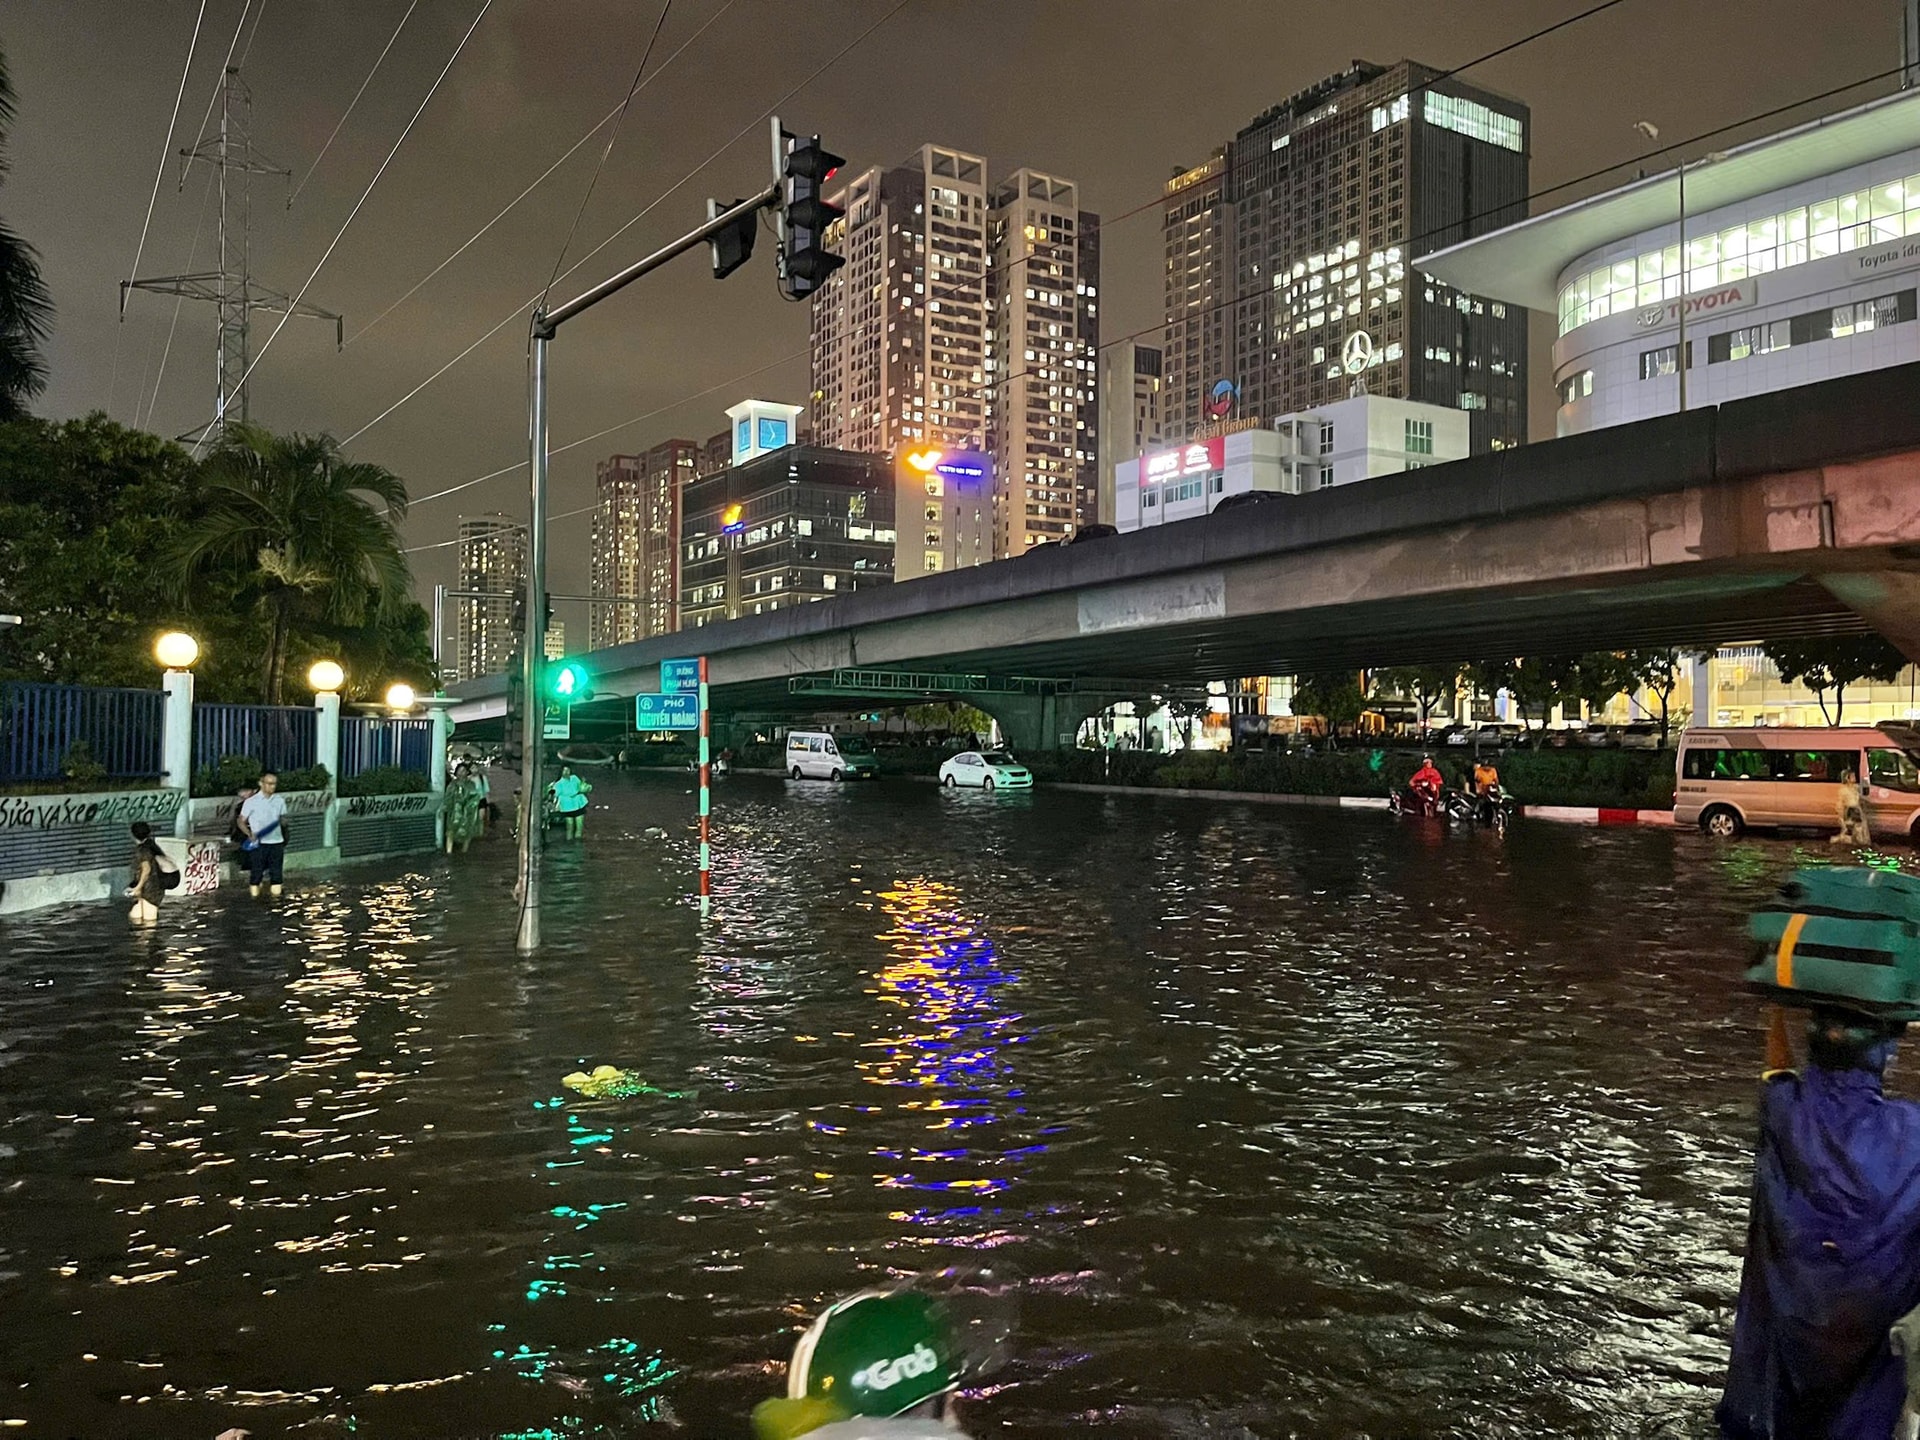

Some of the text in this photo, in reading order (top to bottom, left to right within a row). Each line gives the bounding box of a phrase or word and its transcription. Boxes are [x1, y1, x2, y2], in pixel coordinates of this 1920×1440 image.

[1859, 251, 1898, 268] Toyota
[1667, 288, 1742, 318] TOYOTA
[663, 697, 686, 708] PHỐ
[864, 1342, 938, 1391] Grab
